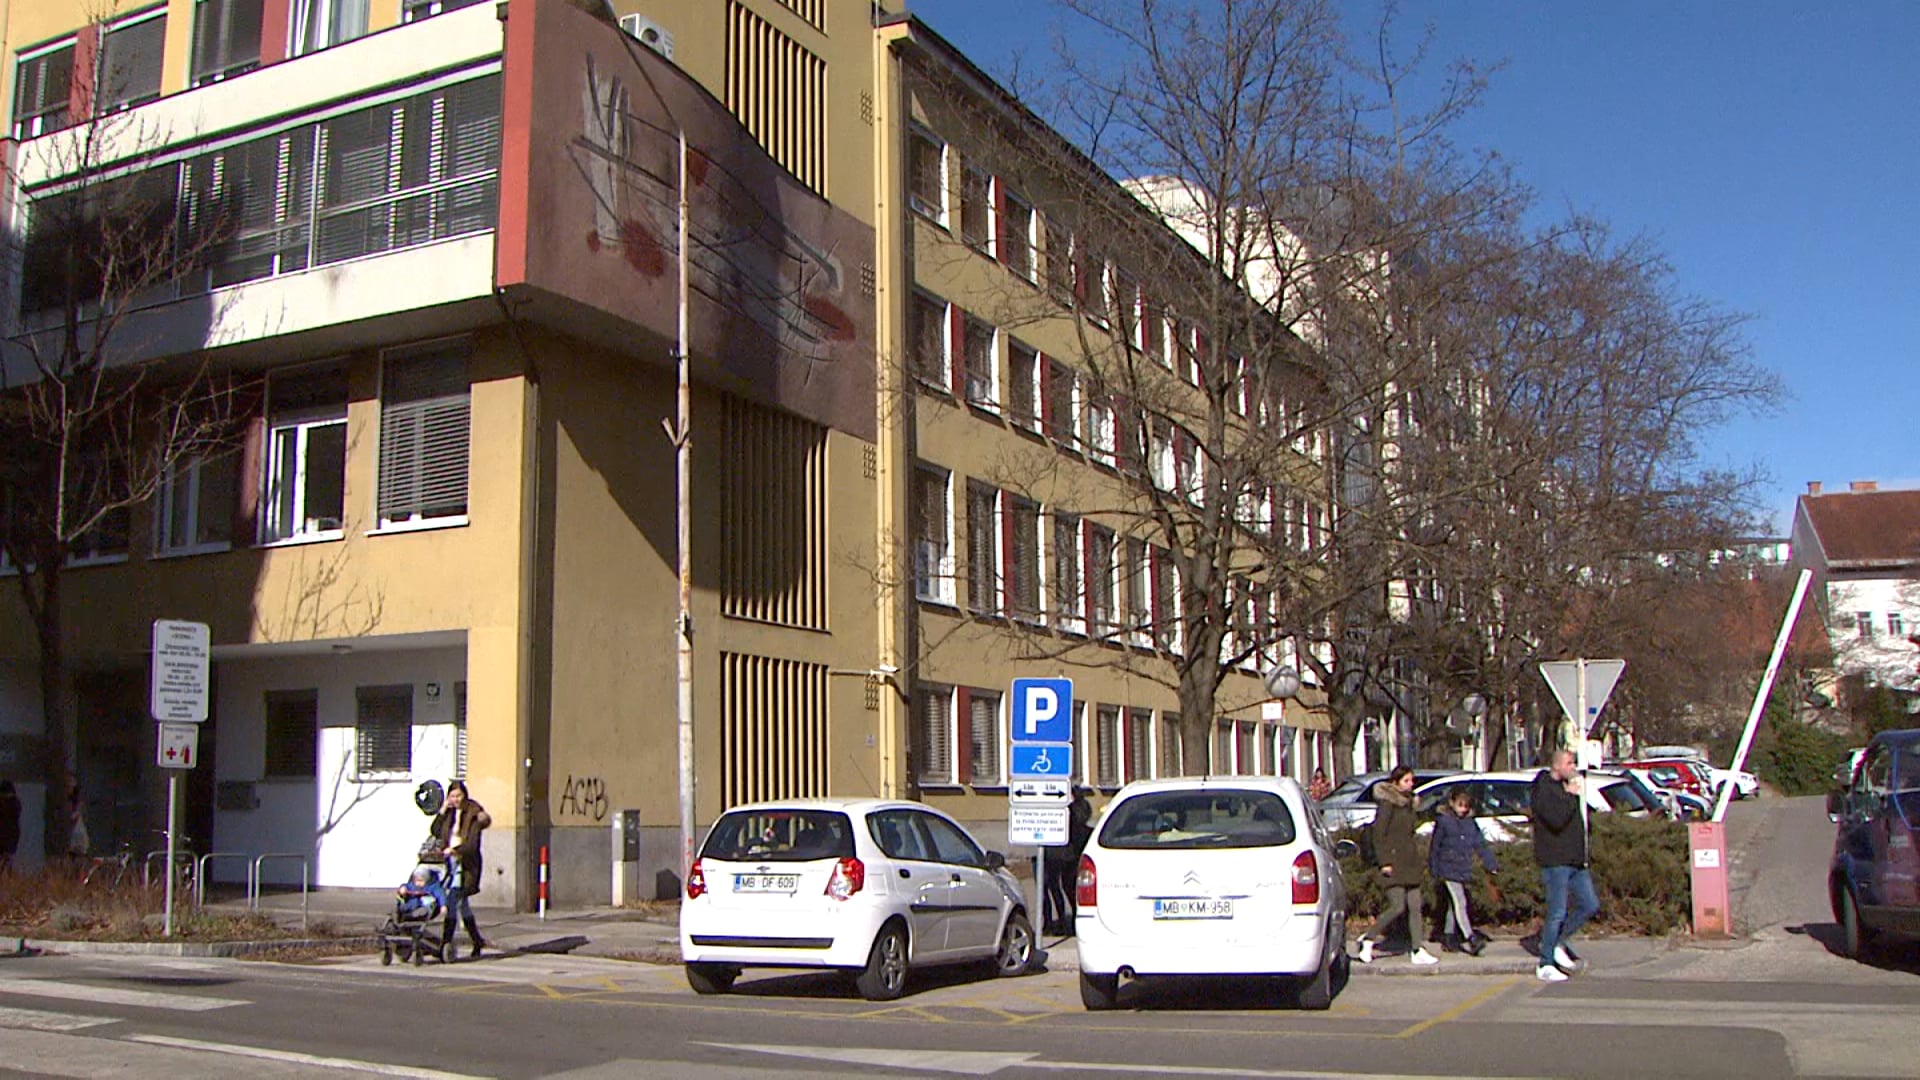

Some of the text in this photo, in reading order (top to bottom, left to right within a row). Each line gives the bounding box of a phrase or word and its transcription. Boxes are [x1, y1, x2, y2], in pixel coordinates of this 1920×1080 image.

[1026, 687, 1058, 734] P
[560, 775, 608, 821] ACAB
[742, 876, 755, 888] MB
[1163, 901, 1179, 914] MB
